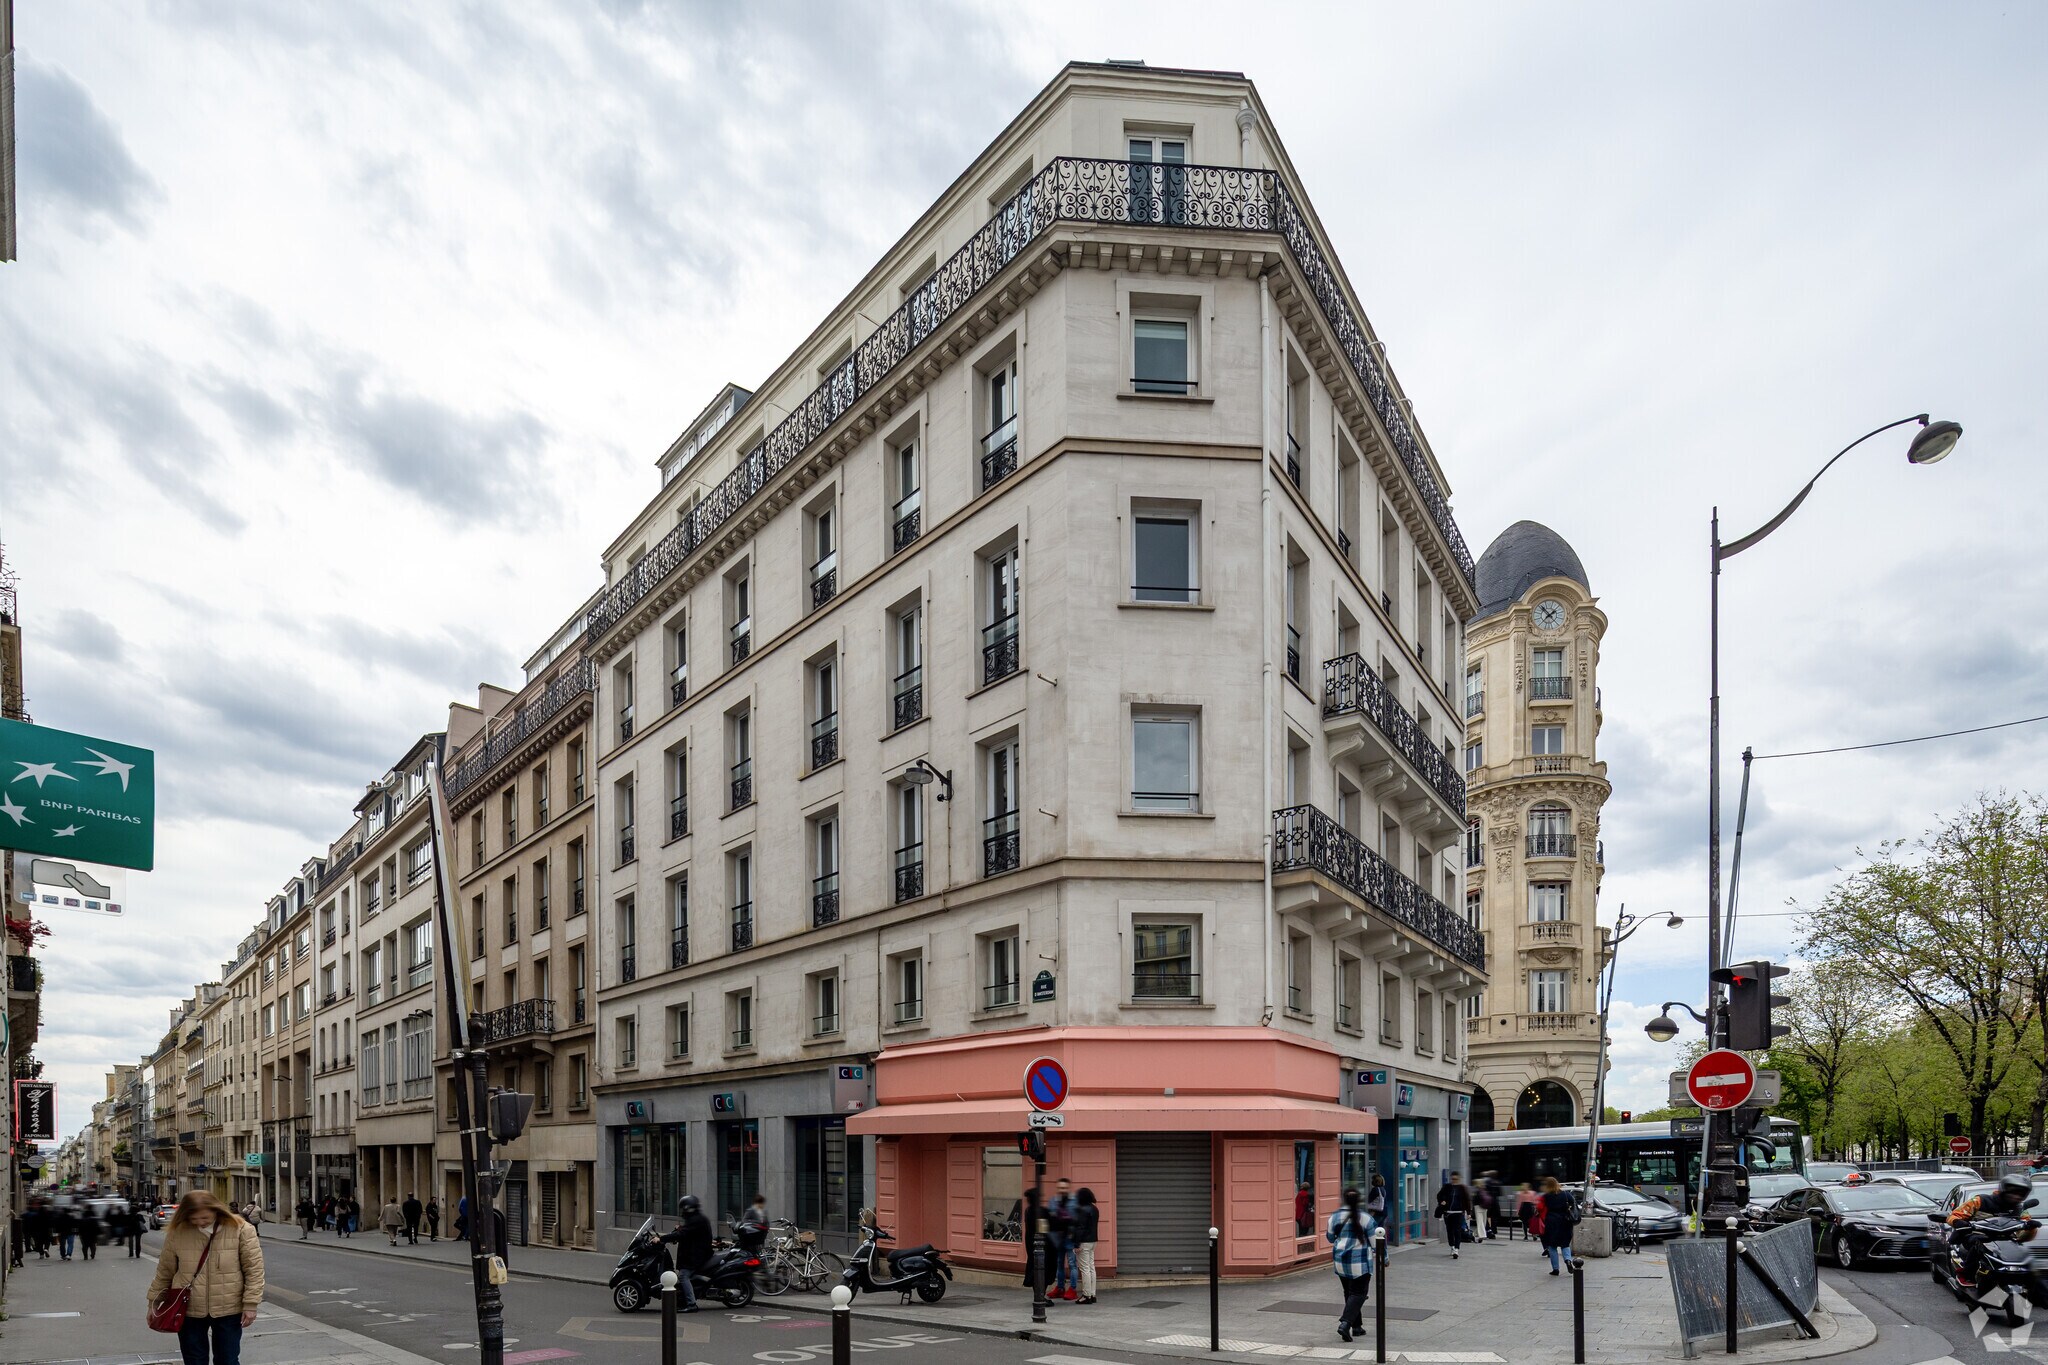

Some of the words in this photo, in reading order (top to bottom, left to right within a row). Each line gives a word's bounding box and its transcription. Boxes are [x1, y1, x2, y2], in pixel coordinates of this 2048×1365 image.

[40, 799, 73, 811] BNP
[77, 806, 142, 825] PARIBAS
[841, 1068, 861, 1078] CIC
[1360, 1072, 1384, 1083] CIC
[1400, 1089, 1412, 1102] CIC
[628, 1103, 643, 1116] CIC
[715, 1096, 733, 1110] CIC
